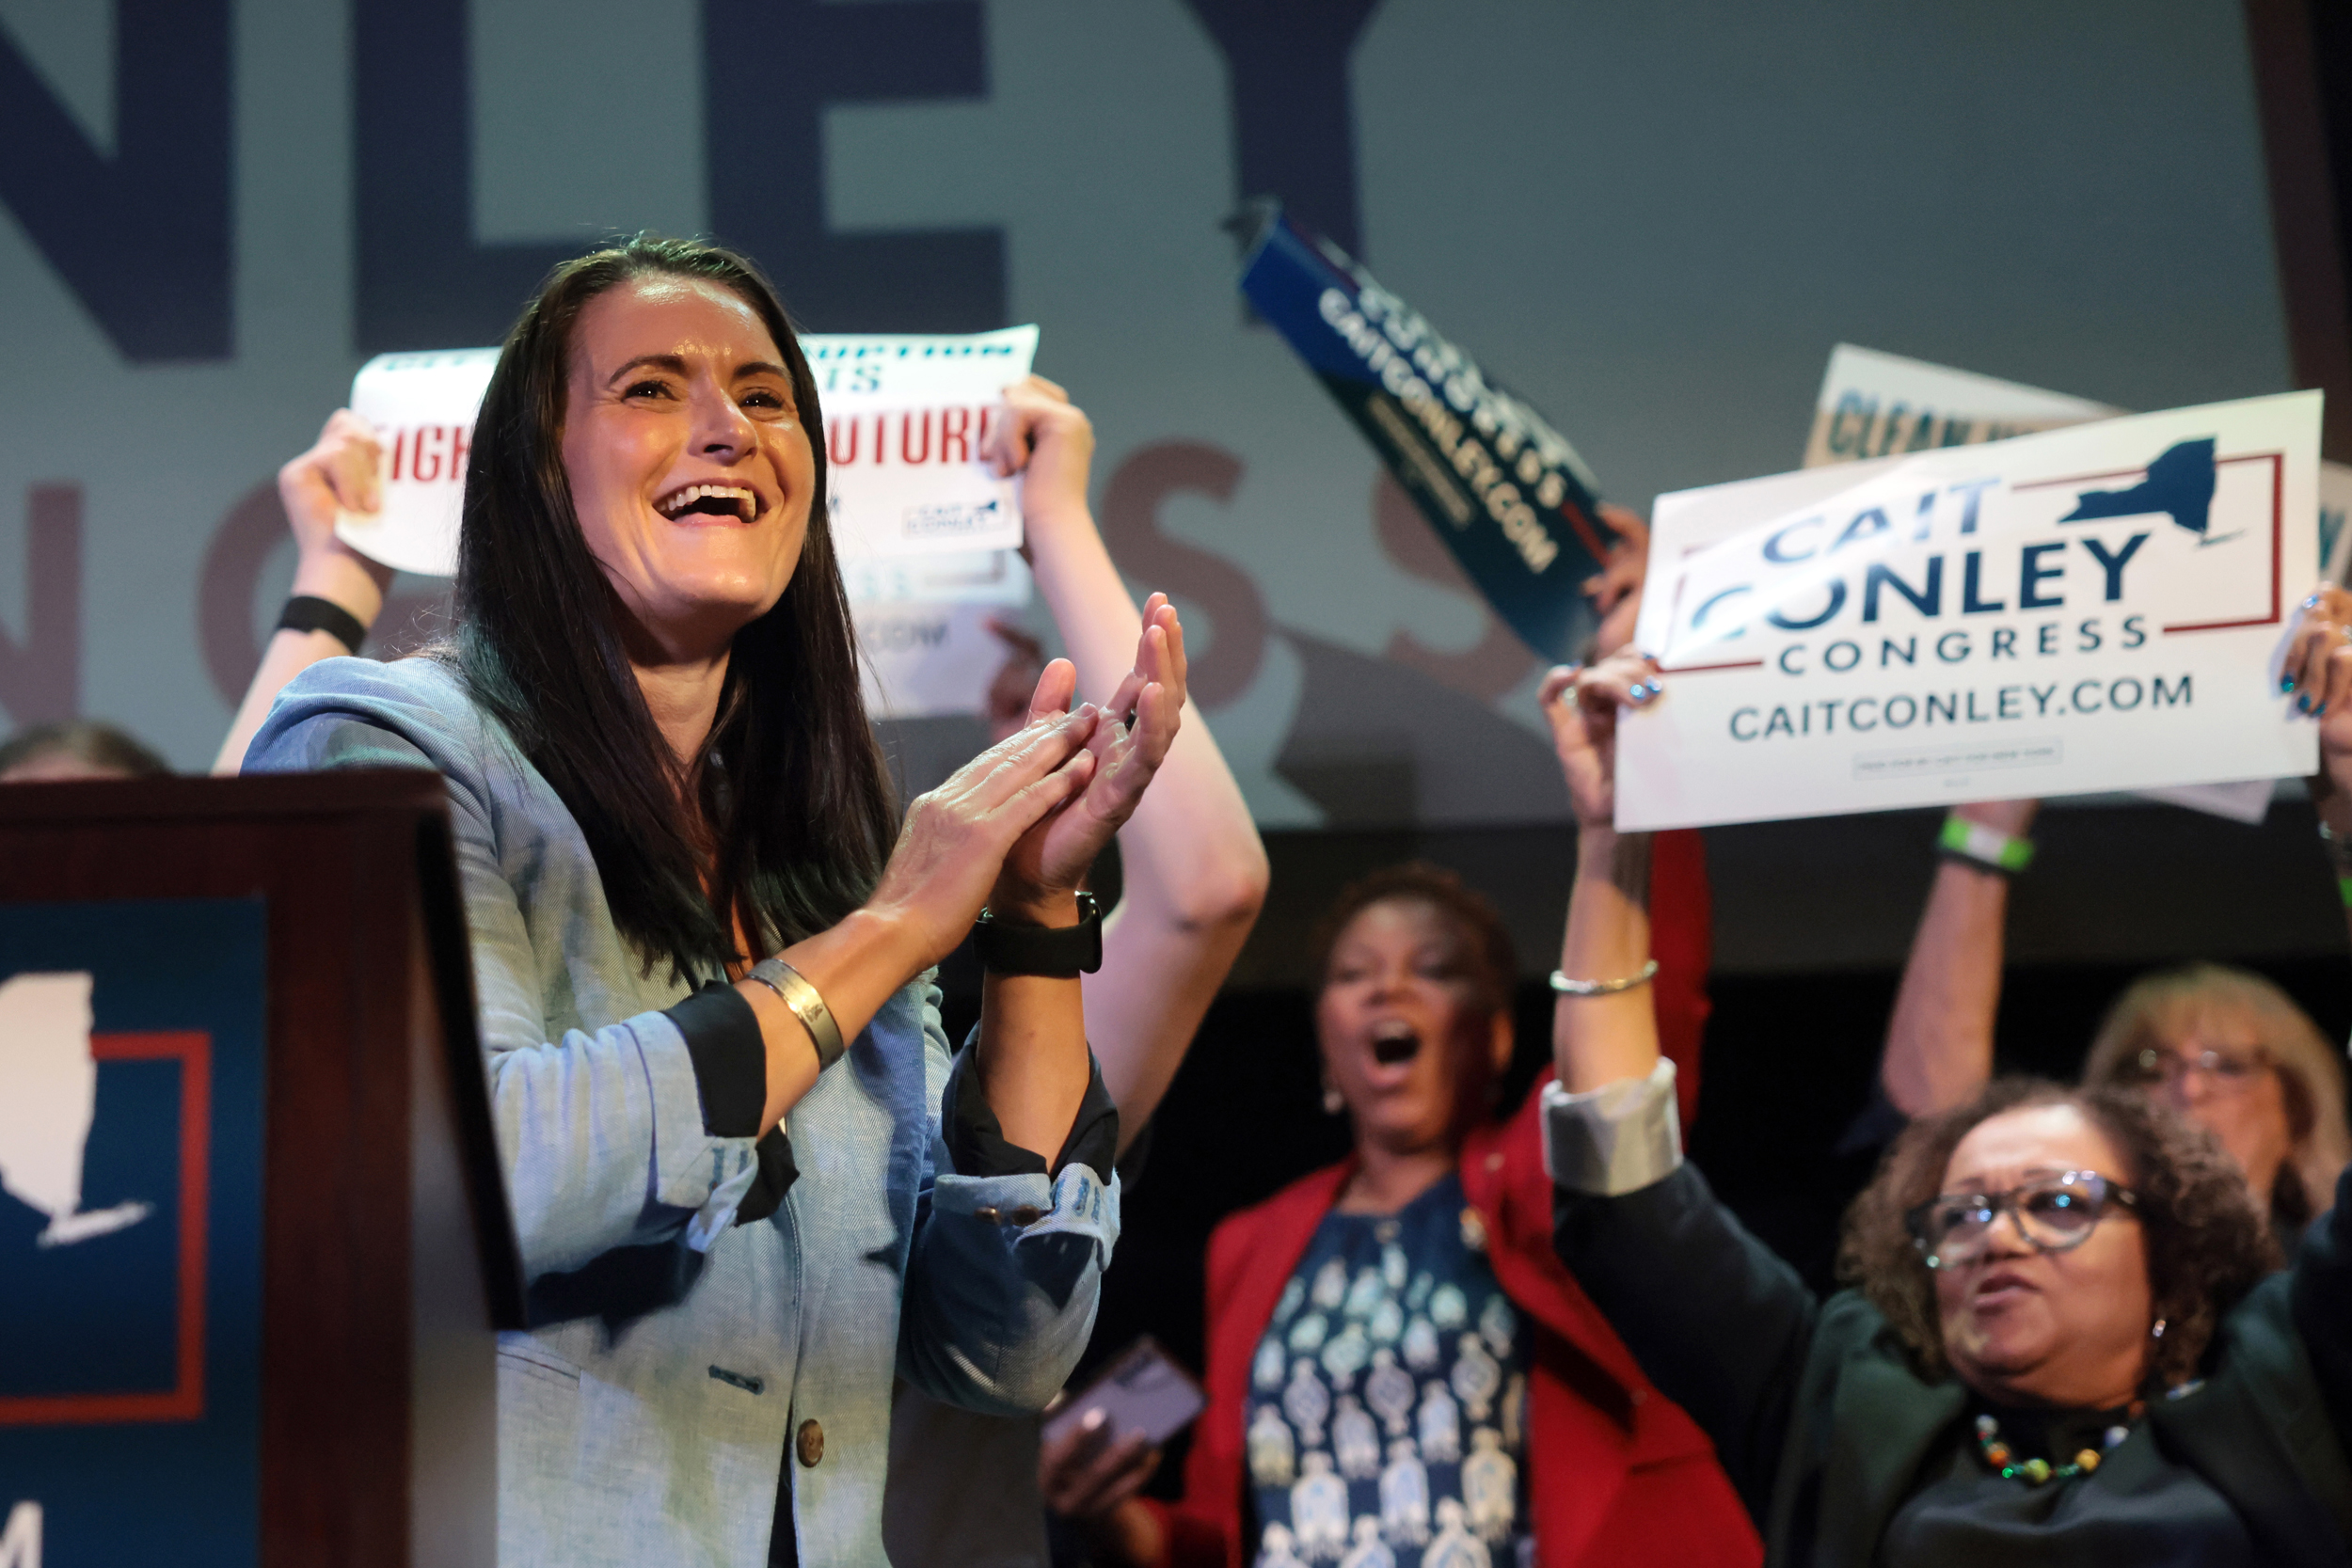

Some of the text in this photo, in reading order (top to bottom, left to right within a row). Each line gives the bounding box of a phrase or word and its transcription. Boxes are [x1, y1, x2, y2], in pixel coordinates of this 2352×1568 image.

[1762, 476, 2002, 564] CAIT
[1691, 531, 2152, 641] CONLEY
[1778, 615, 2148, 676] CONGRESS
[1728, 674, 2195, 741] CAITCONLEY.COM
